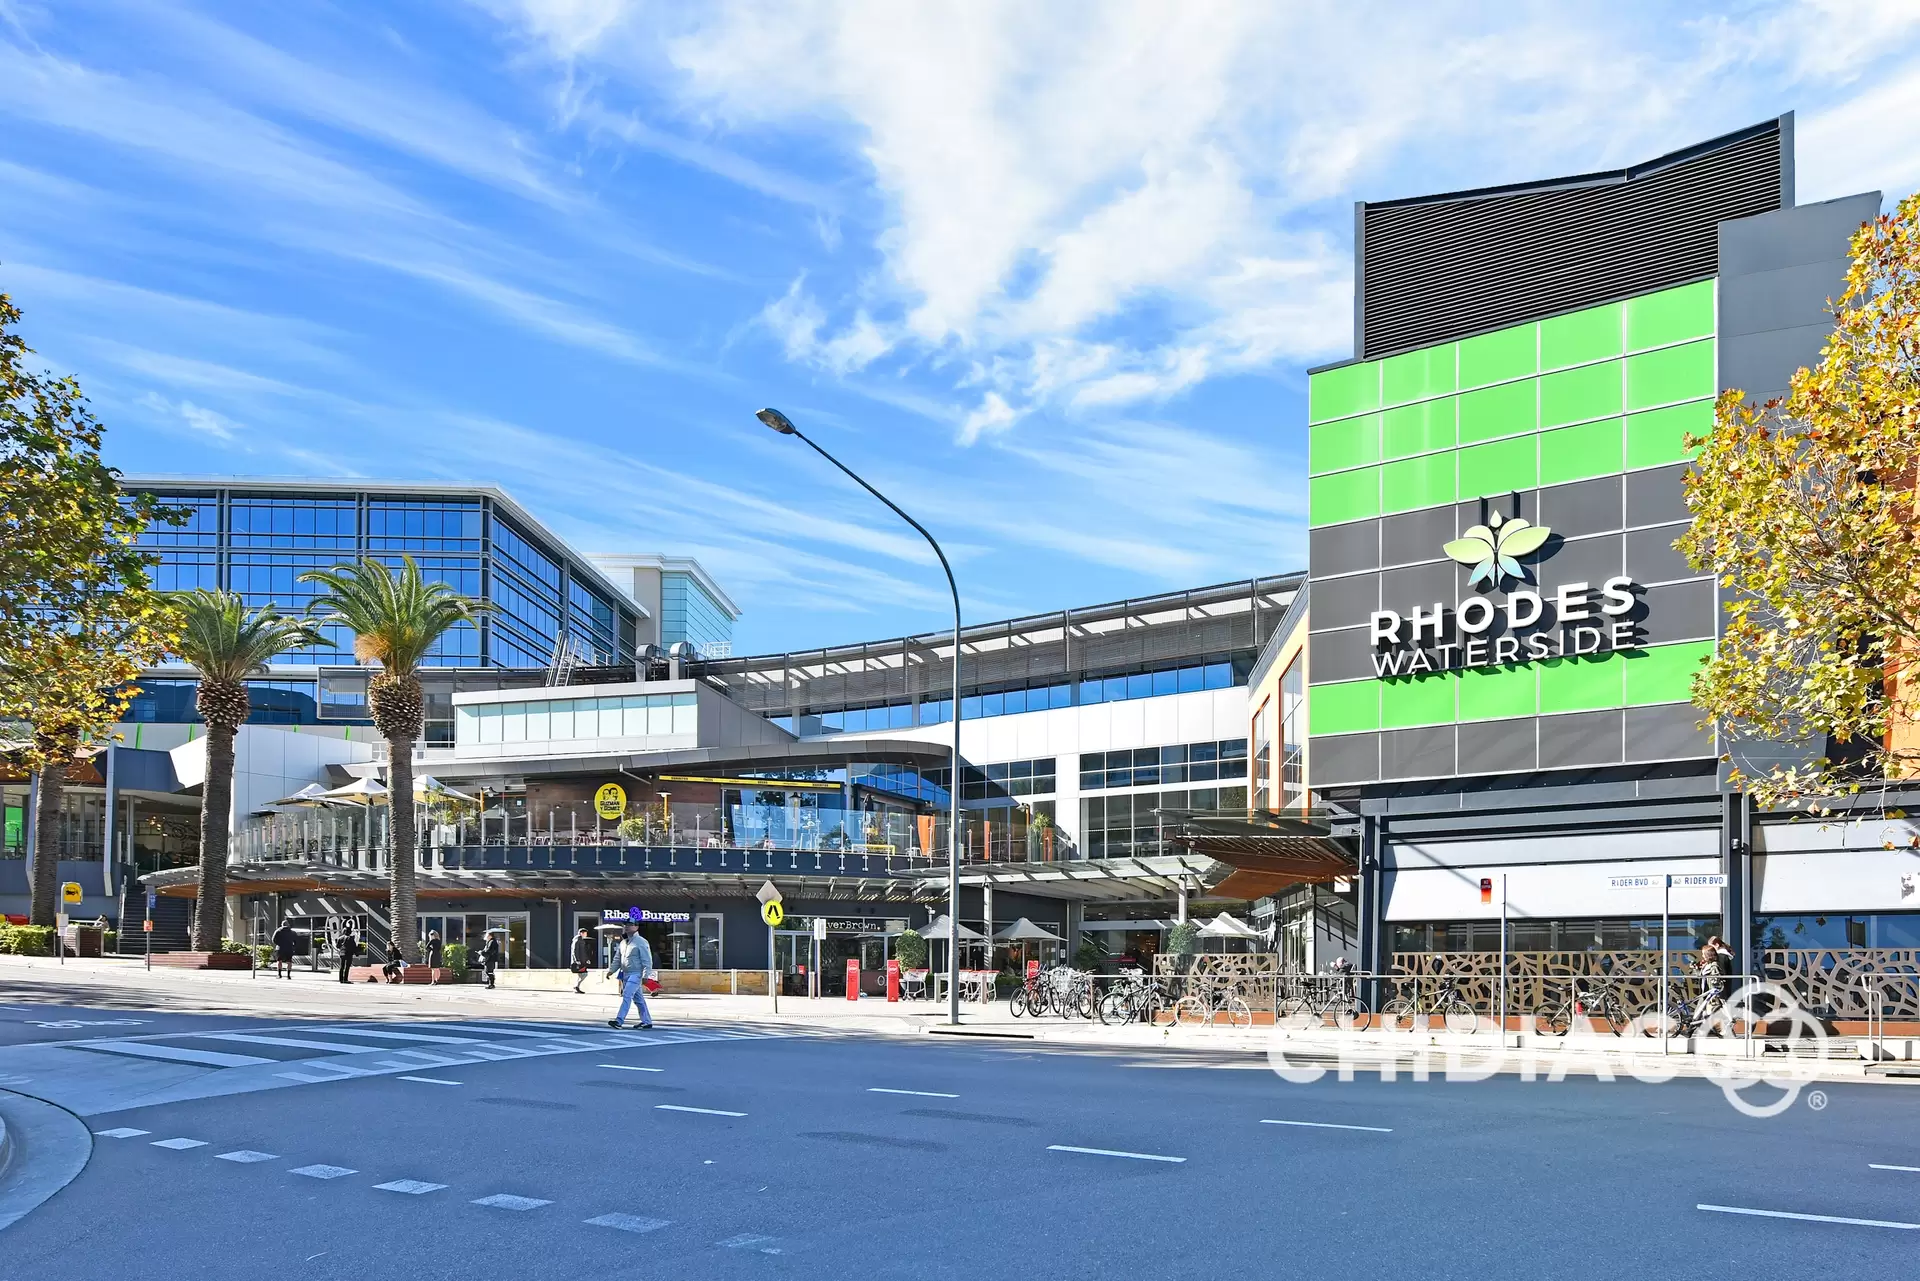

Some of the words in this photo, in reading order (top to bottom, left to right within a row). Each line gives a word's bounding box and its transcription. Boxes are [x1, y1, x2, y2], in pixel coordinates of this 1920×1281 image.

[1370, 576, 1636, 646] RHODES
[1371, 621, 1636, 677] WATERSIDE
[1611, 878, 1633, 887] RIDER
[1635, 878, 1649, 886] BVD
[1684, 876, 1707, 885] RIDER
[1709, 876, 1724, 885] BVD
[603, 909, 630, 920] Ribs
[641, 909, 690, 923] Burgers
